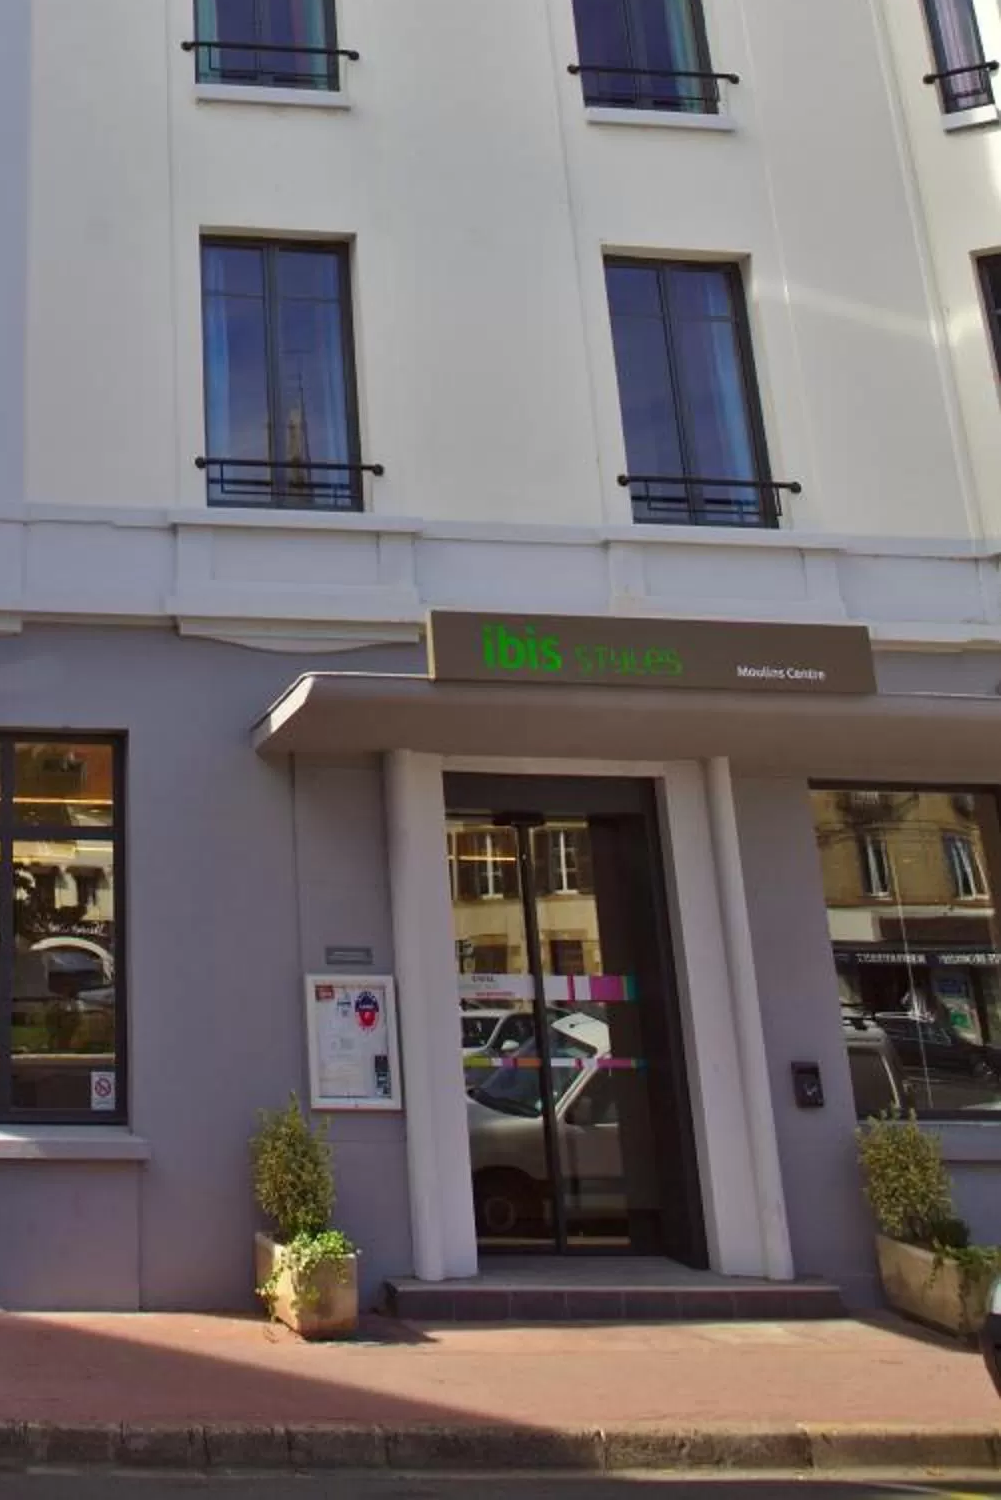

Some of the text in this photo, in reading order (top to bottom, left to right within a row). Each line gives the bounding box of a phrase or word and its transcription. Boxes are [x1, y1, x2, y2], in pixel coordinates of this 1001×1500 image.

[483, 623, 563, 672] ibis
[737, 666, 826, 681] Moulins Centre
